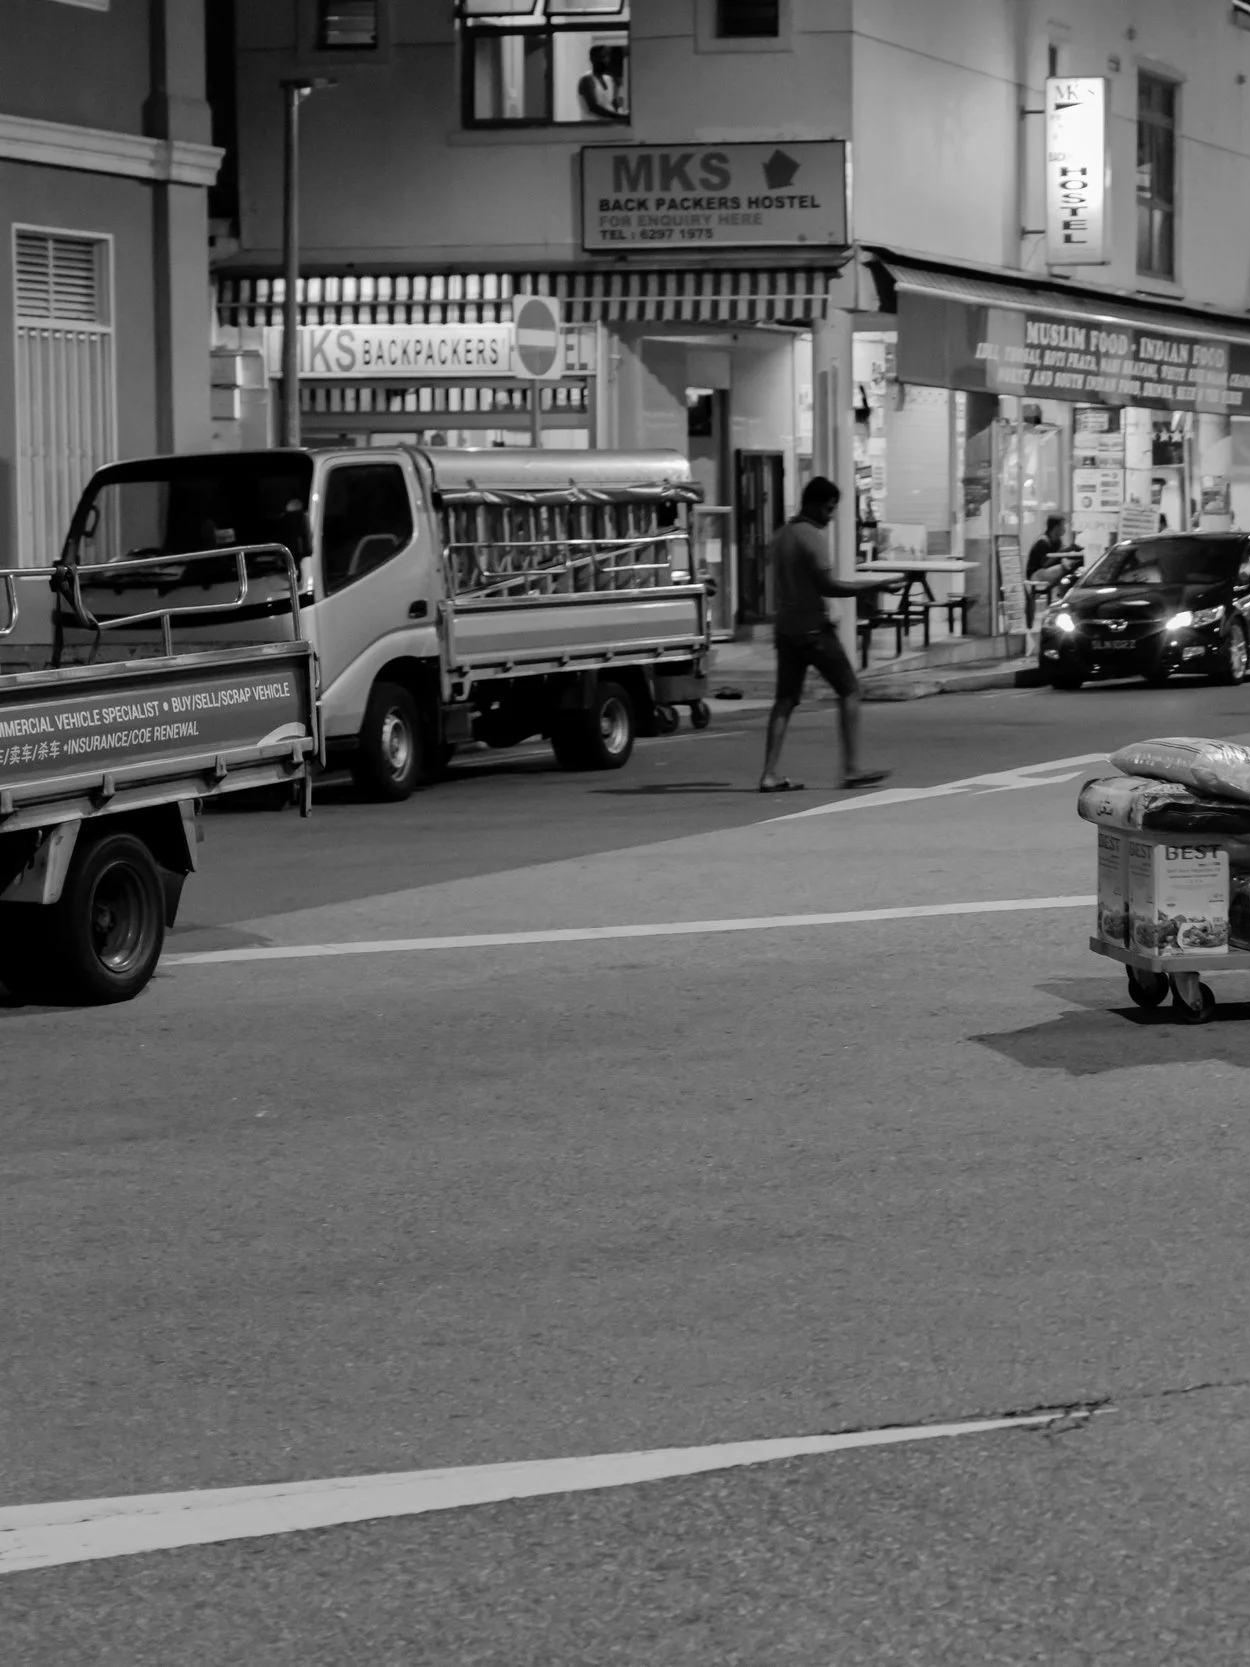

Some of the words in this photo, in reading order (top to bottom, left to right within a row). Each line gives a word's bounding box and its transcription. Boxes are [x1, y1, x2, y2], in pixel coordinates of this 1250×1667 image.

[613, 152, 731, 193] MKS
[599, 198, 648, 212] BACK
[655, 196, 741, 211] PACKERS
[747, 195, 821, 209] HOSTEL
[599, 215, 632, 227] FOR
[636, 213, 712, 227] ENQUIRY
[718, 212, 763, 226] HERE
[1060, 167, 1088, 244] HOSTEL
[299, 329, 357, 372] KS
[1026, 321, 1086, 350] MUSLIM
[1090, 330, 1129, 355] FOOD
[1139, 337, 1190, 363] INDIAN
[1192, 344, 1226, 367] FOOD
[54, 709, 101, 730] VEHICLE
[102, 701, 159, 724] SPECIALIST
[171, 687, 252, 713] BUY/SELL/SCRAP
[251, 682, 290, 701] VEHICLE
[154, 721, 199, 741] RENEWAL
[1165, 844, 1223, 861] BEST
